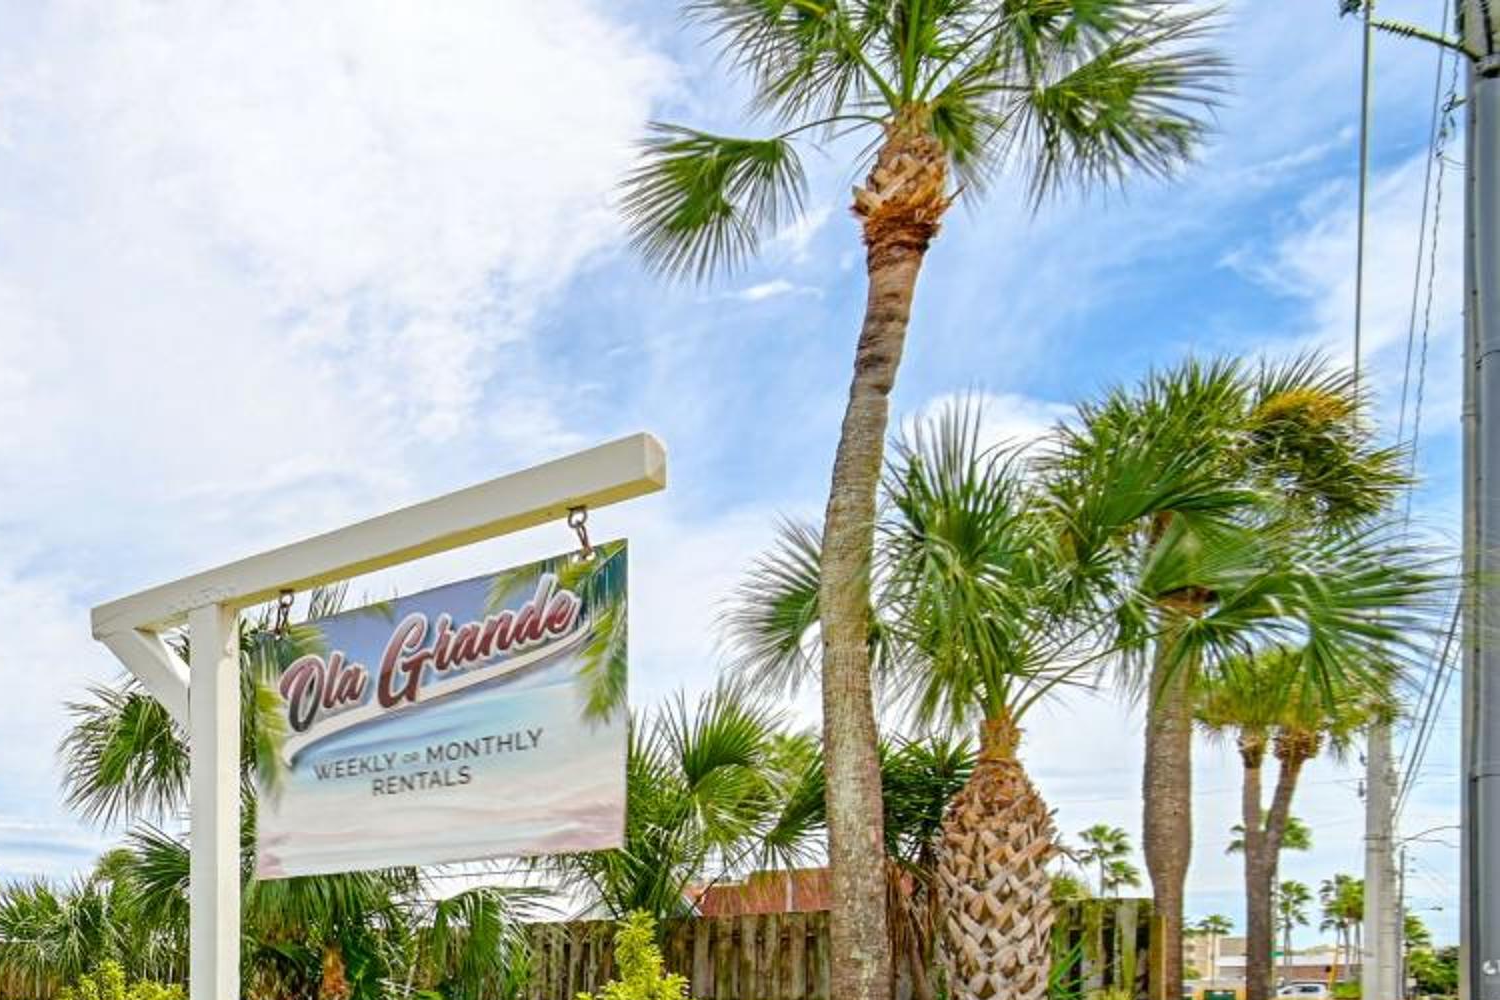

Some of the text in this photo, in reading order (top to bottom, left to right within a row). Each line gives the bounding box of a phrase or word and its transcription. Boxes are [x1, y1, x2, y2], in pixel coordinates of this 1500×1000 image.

[279, 573, 581, 733] Ola Grande
[313, 752, 397, 781] WEEKLY
[425, 727, 543, 765] MONTHLY
[372, 765, 472, 797] RENTALS
